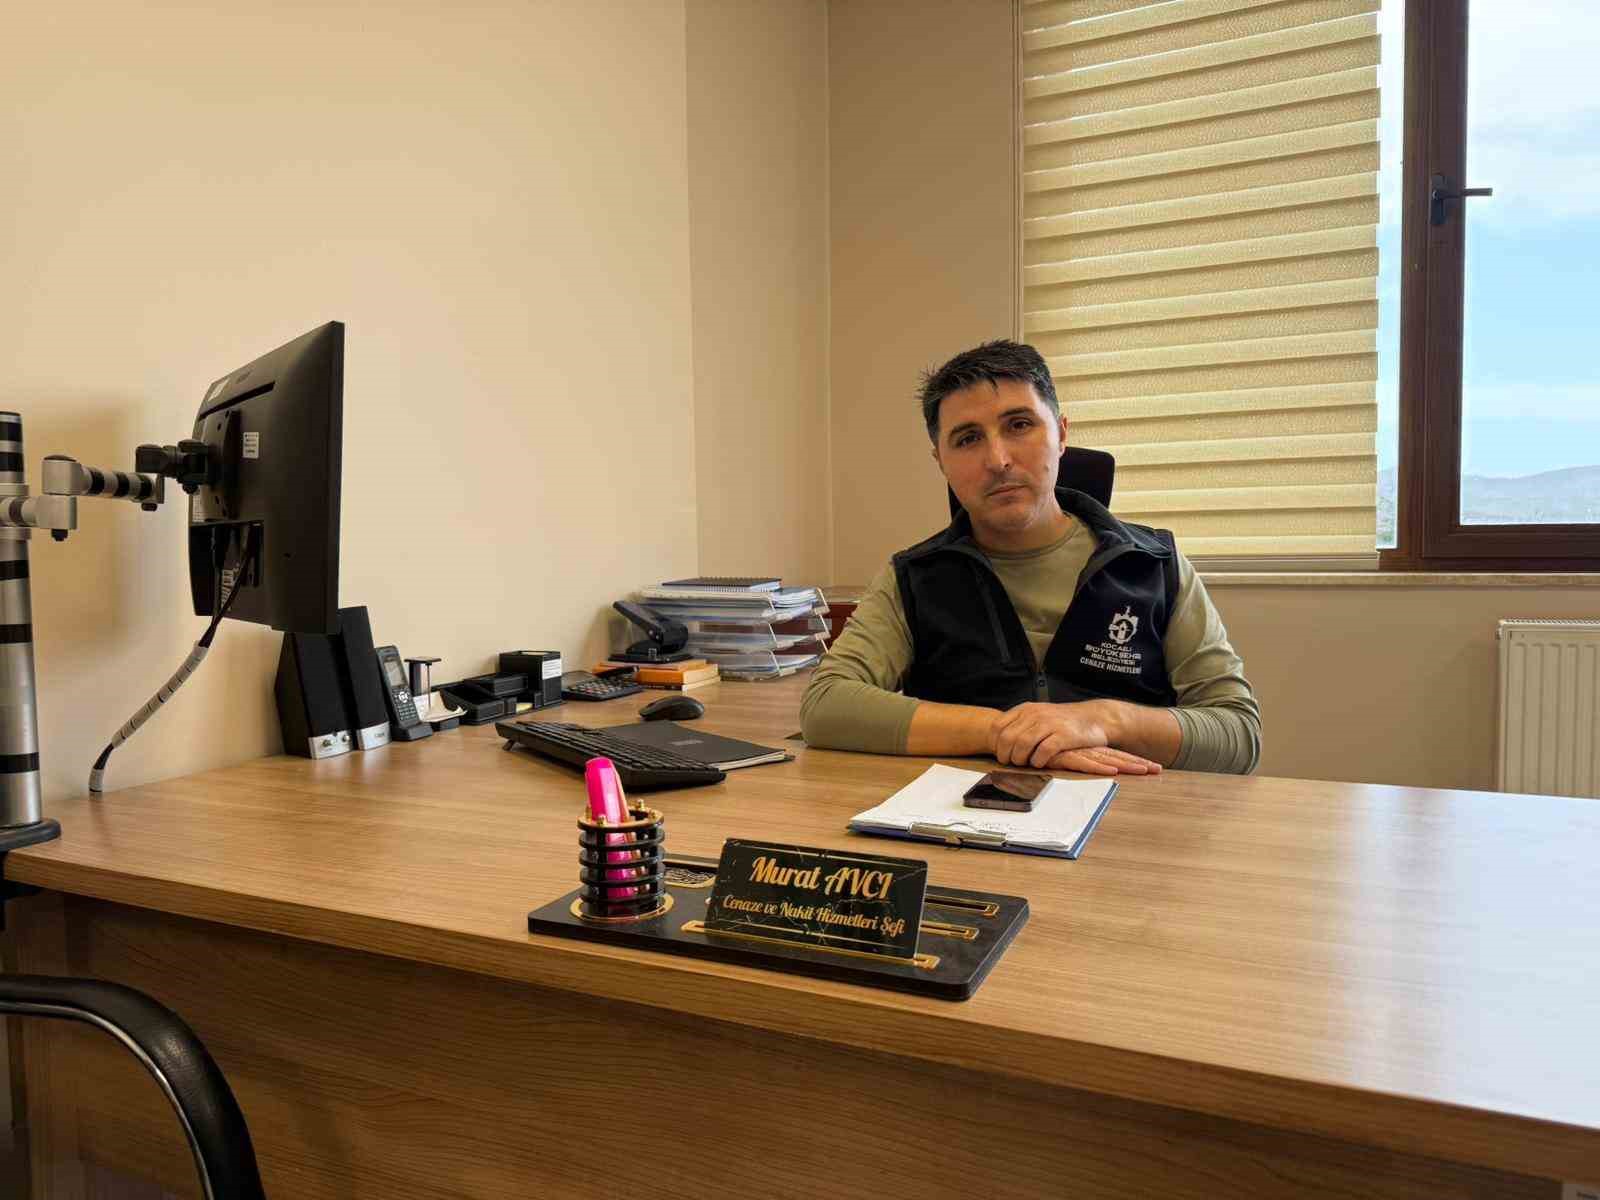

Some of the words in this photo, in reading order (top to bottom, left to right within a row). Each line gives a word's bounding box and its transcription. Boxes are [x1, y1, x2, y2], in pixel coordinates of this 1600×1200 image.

[749, 856, 821, 890] Murat
[825, 867, 893, 899] AVCI
[723, 895, 763, 913] Cenaze
[764, 904, 778, 914] ve
[816, 907, 878, 930] Hizmetleri
[880, 917, 905, 937] Şefi
